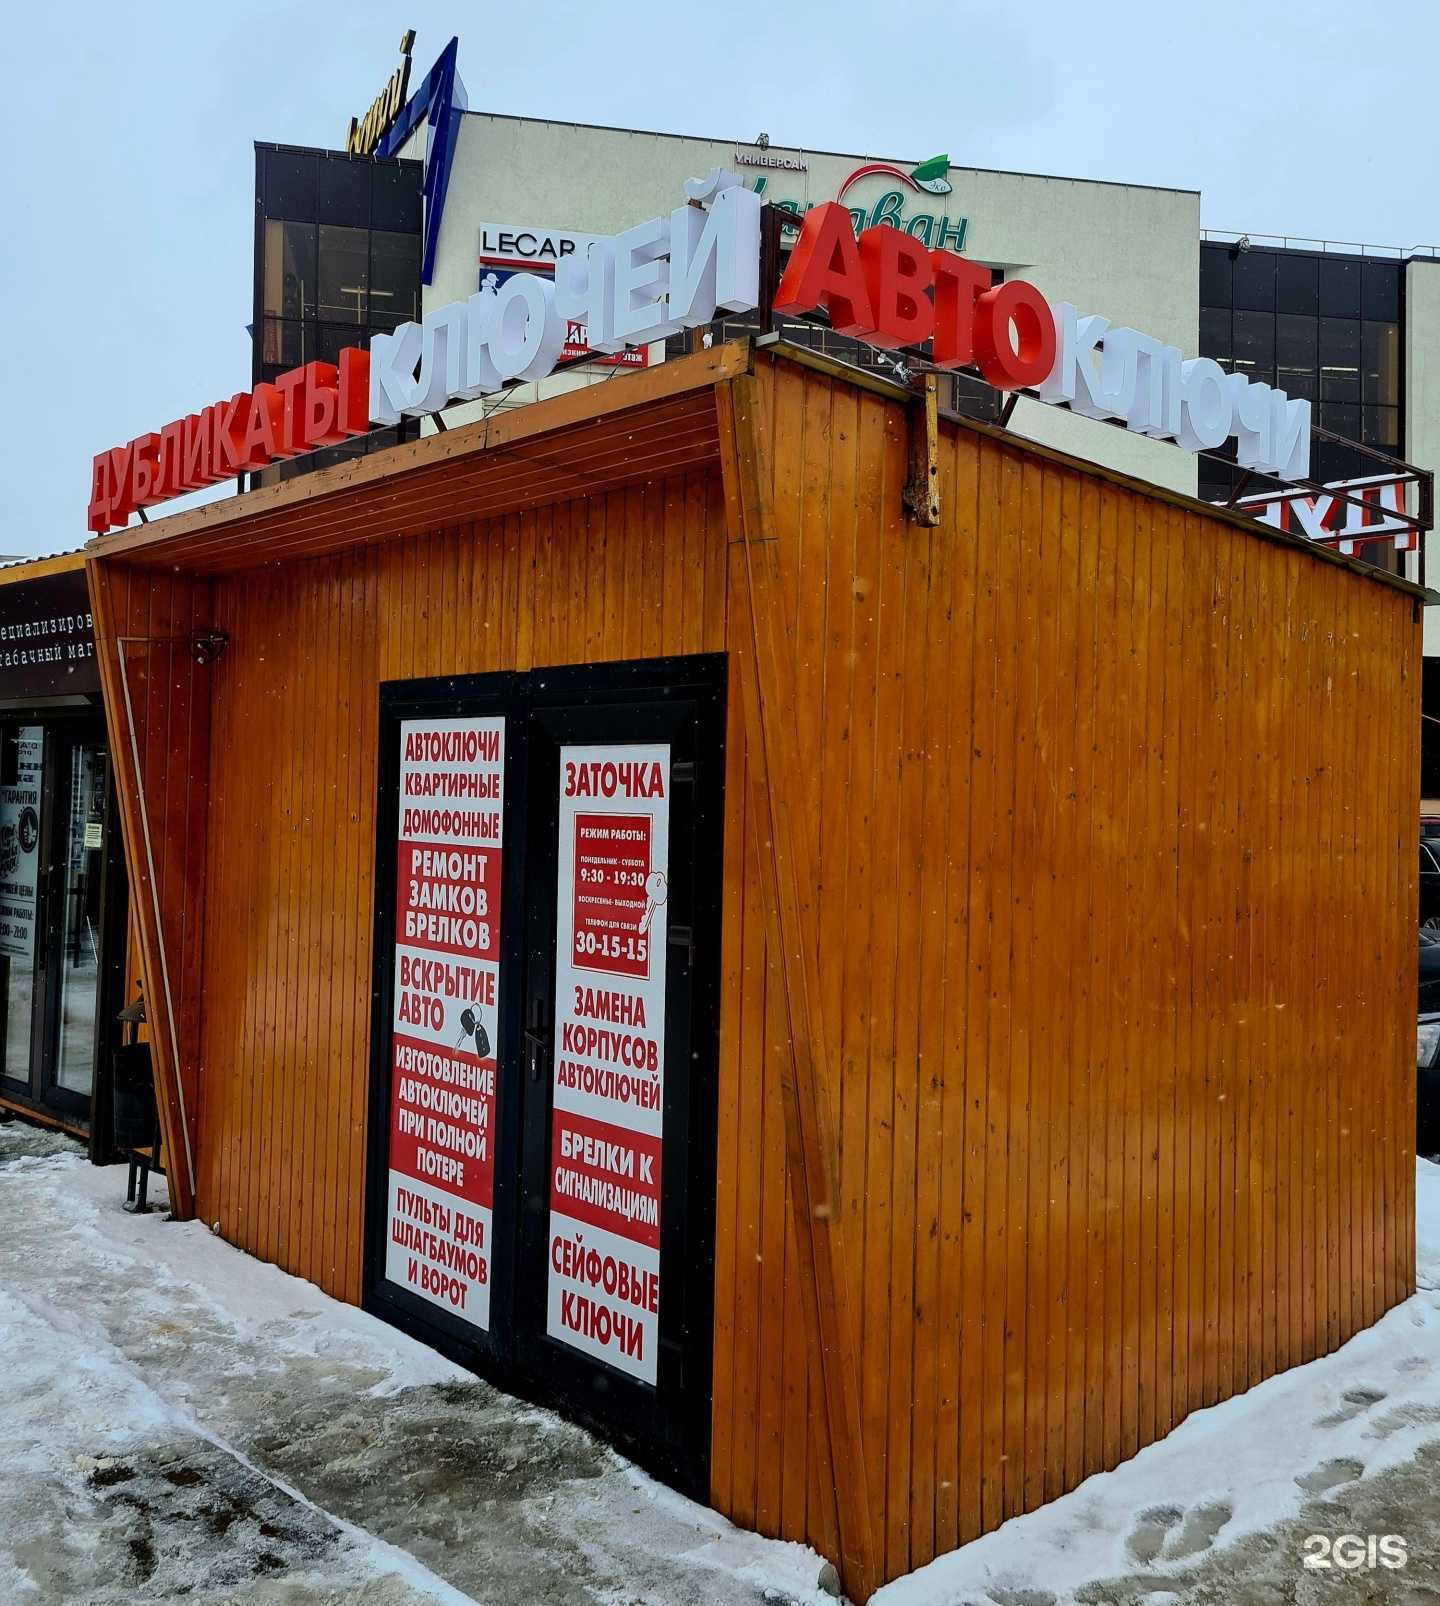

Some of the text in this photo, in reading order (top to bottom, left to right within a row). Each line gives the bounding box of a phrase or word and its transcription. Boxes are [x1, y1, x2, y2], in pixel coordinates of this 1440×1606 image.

[735, 152, 809, 172] УНИВЕРСАМ
[88, 167, 761, 532] ДУБЛИКАТЫ КЛЮЧЕЙ
[0, 613, 93, 641] ециализиров
[68, 642, 93, 659] маг
[405, 731, 500, 762] АВТОКЛЮЧИ
[404, 772, 500, 799] КВАРТИРНЫЕ
[564, 762, 664, 798] ЗАТОЧКА
[403, 808, 499, 839] ДОМОФОННЫЕ
[580, 828, 646, 841] РЕЖИМ РАБОТЫ:
[411, 849, 488, 883] РЕМОНТ
[580, 856, 618, 866] ПОНЕДЕЛЬНИК
[621, 859, 645, 867] СУББОТА
[580, 868, 604, 883] 9:30
[613, 871, 645, 887] 19:30
[409, 879, 487, 917] ЗАМКОВ
[615, 897, 646, 909] ВЫХОДНОЙ
[405, 911, 490, 950] БРЕЛКОВ
[585, 918, 638, 931] ТЕЛЕФОН ДЛЯ СВЯЗИ
[576, 931, 647, 962] 30-15-15
[400, 955, 495, 1005] ВСКРЫТИЕ
[398, 991, 444, 1031] АВТО
[574, 985, 646, 1028] ЗАМЕНА
[562, 1022, 658, 1071] КОРПУСОВ
[396, 1045, 494, 1096] ИЗГОТОВЛЕНИЕ
[558, 1060, 660, 1111] АВТОКЛЮЧЕЙ
[398, 1078, 488, 1128] АВТОКЛЮЧЕЙ
[398, 1107, 486, 1162] ПРИ ПОЛНОЙ
[416, 1147, 464, 1187] ПОТЕРЕ
[561, 1129, 654, 1185] БРЕЛКИ К
[555, 1166, 658, 1227] СИГНАЛИЗАЦИЯМ
[397, 1188, 484, 1249] ПУЛЬТЫ ДЛЯ
[392, 1217, 488, 1285] ШЛАГБАУМОВ
[408, 1257, 468, 1310] И ВОРОТ
[552, 1233, 659, 1314] СЕЙФОВЫЕ
[561, 1289, 643, 1361] КЛЮЧИ
